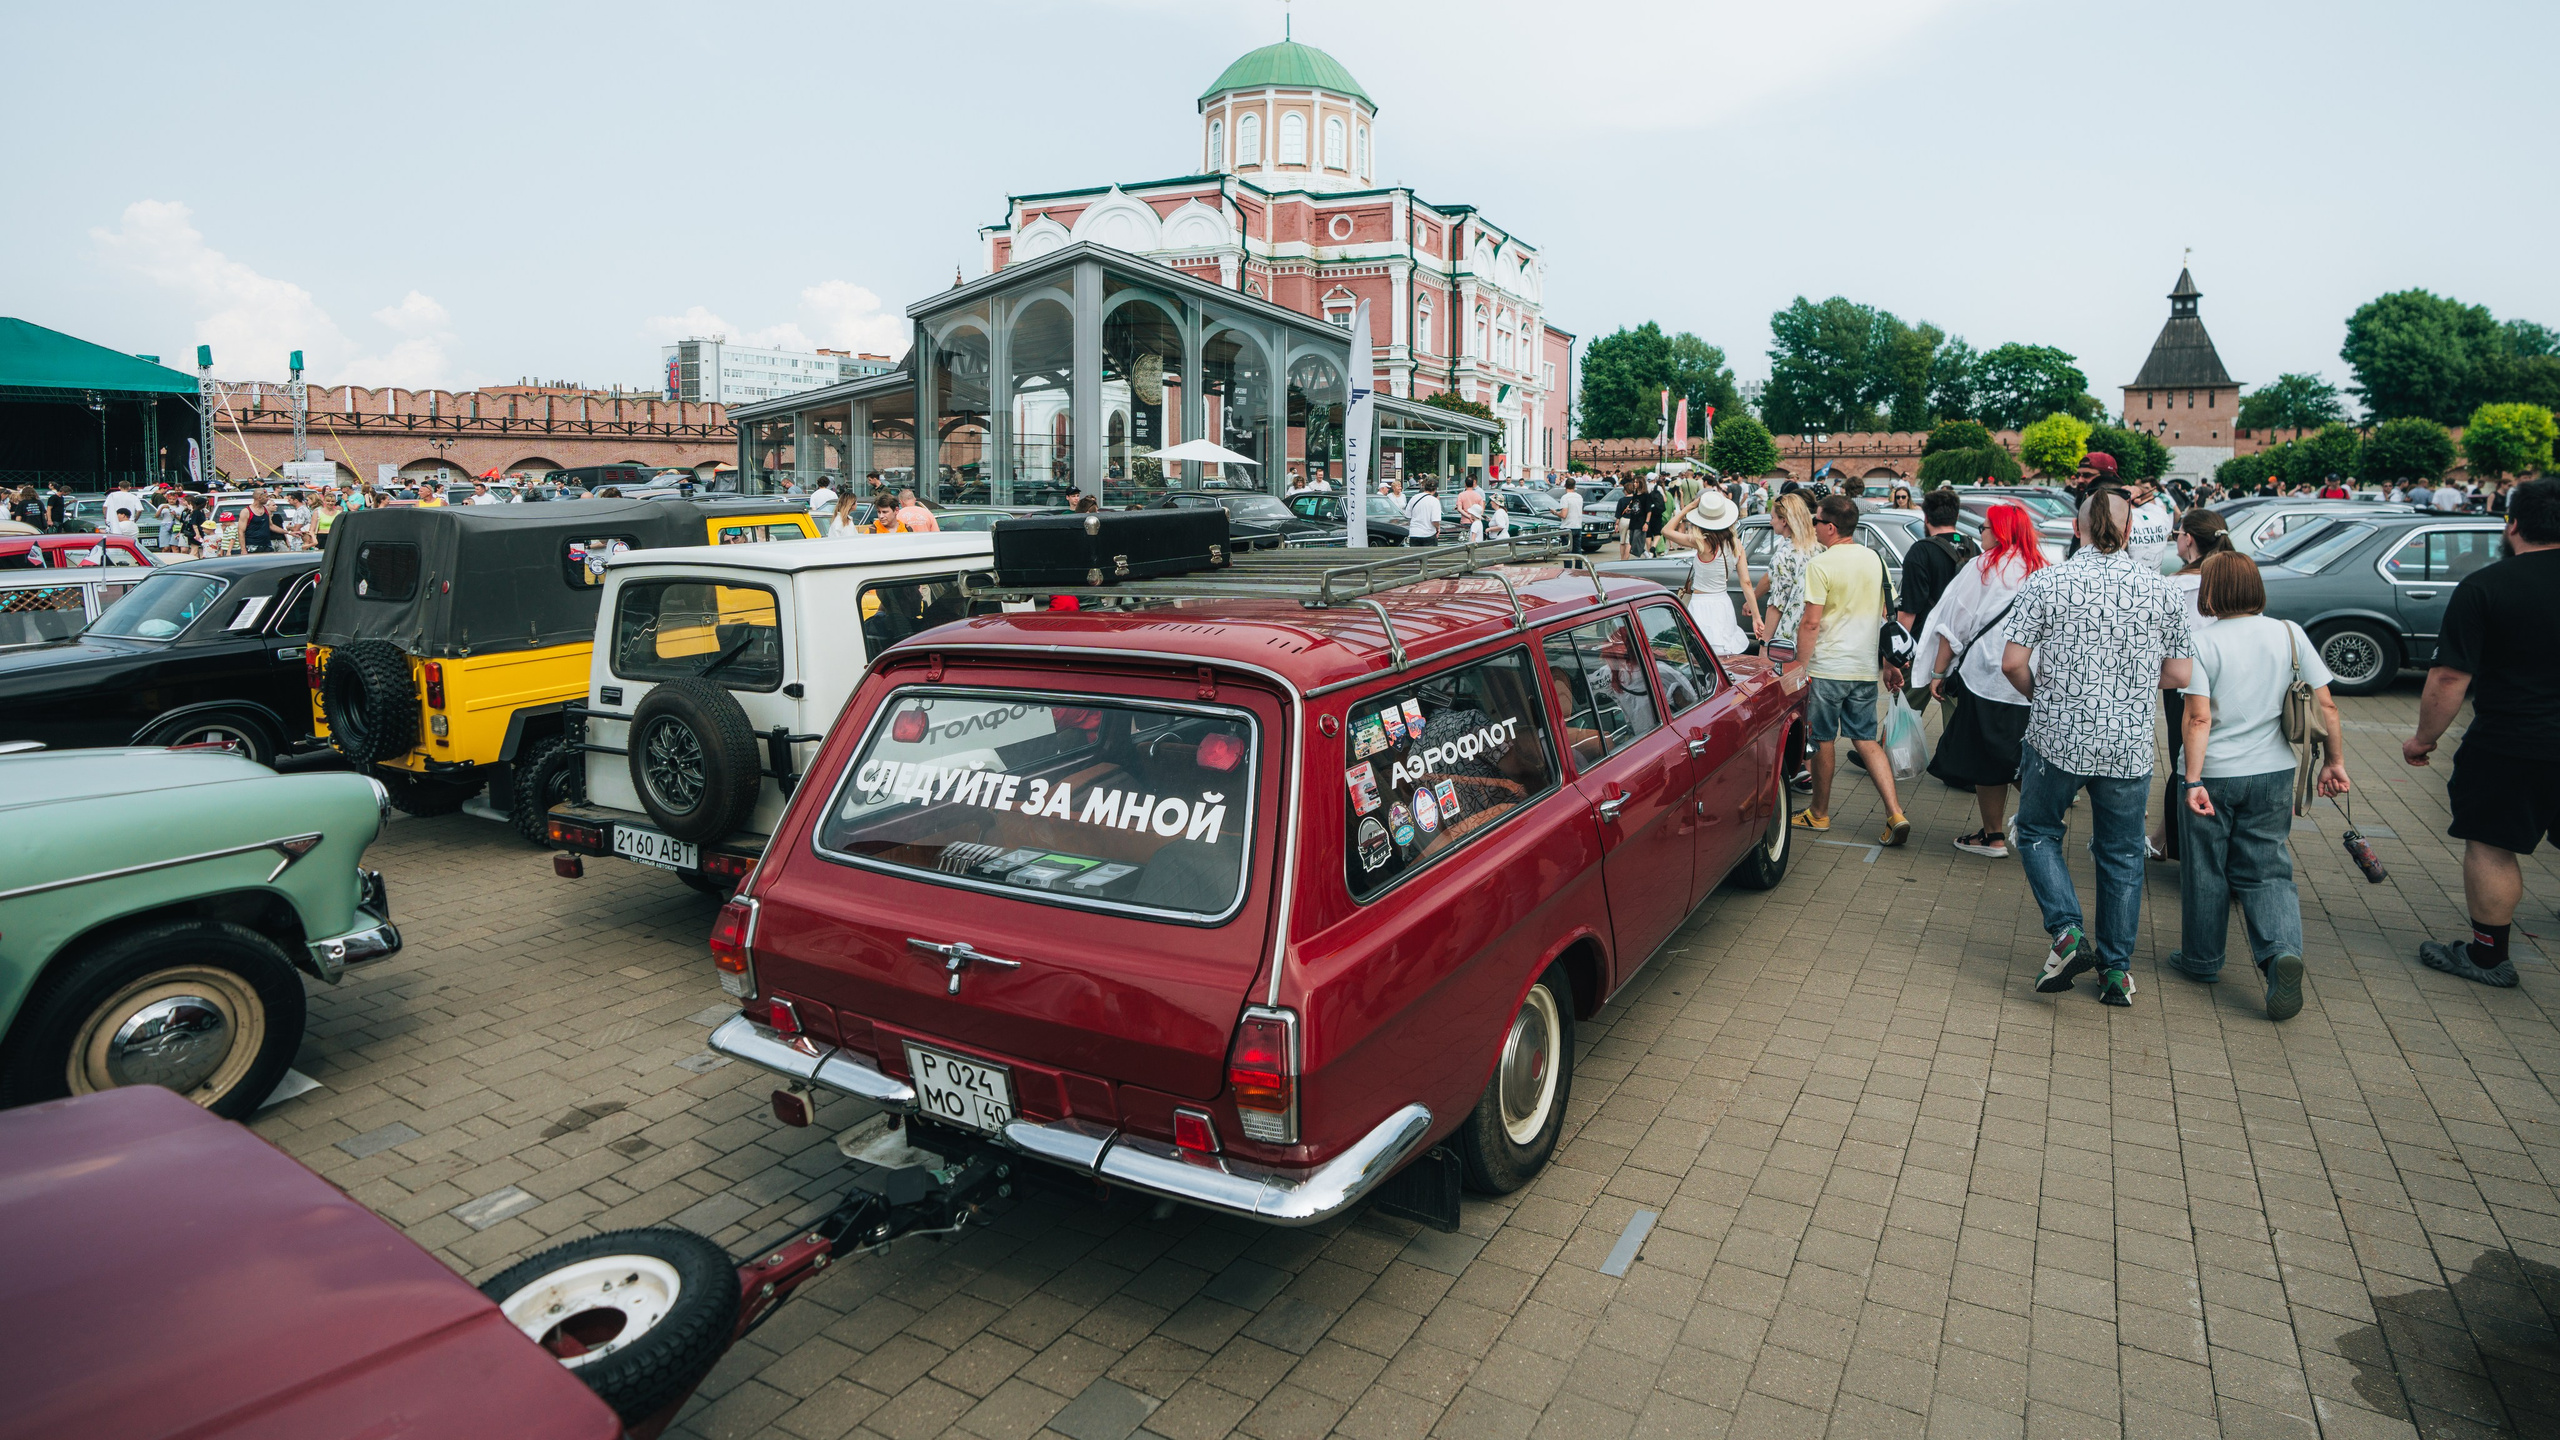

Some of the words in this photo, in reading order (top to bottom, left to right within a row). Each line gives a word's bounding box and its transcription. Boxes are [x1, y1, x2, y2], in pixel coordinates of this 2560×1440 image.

[1348, 438, 1357, 522] ОБЛАСТИ
[2129, 534, 2164, 545] MASKIN
[1391, 716, 1518, 790] АЭРОФЛОТ
[856, 758, 1021, 812] СЛЕДУЙТЕ
[1021, 779, 1071, 820] ЗА
[1078, 786, 1227, 844] МНОЙ
[618, 829, 654, 856] 2160
[946, 1060, 994, 1097] 024
[983, 1102, 1006, 1125] 40
